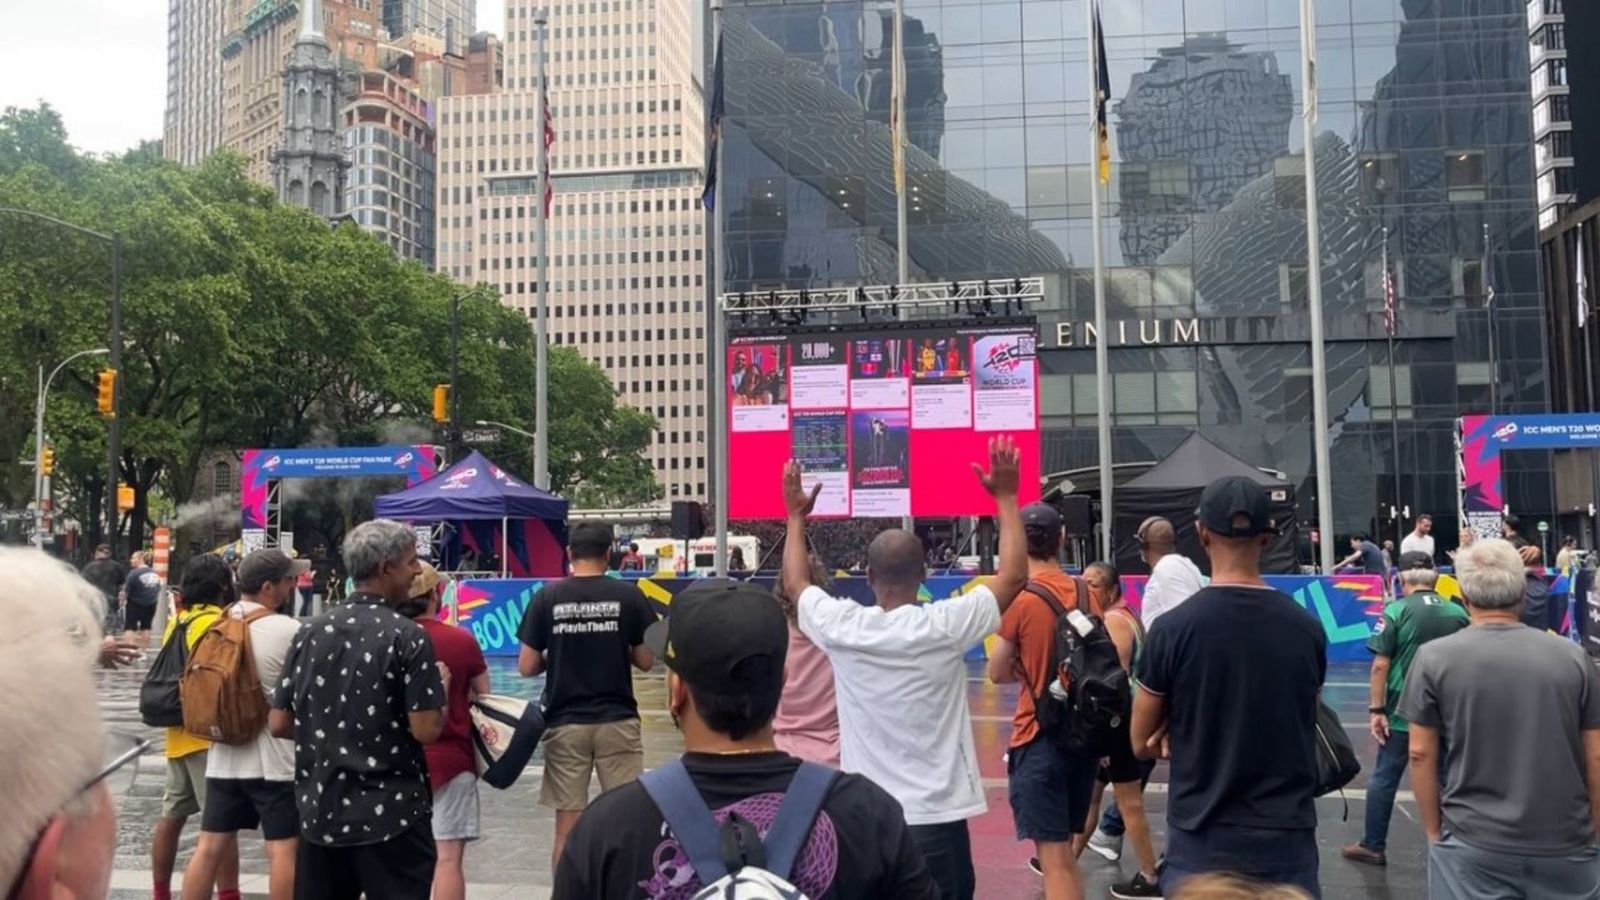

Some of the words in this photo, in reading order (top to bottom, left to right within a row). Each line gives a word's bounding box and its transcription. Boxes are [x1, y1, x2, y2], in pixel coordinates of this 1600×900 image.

[1523, 426, 1538, 434] ICC
[1540, 425, 1567, 434] MEN'S
[1568, 424, 1584, 433] T20
[553, 601, 621, 615] ATLANTA
